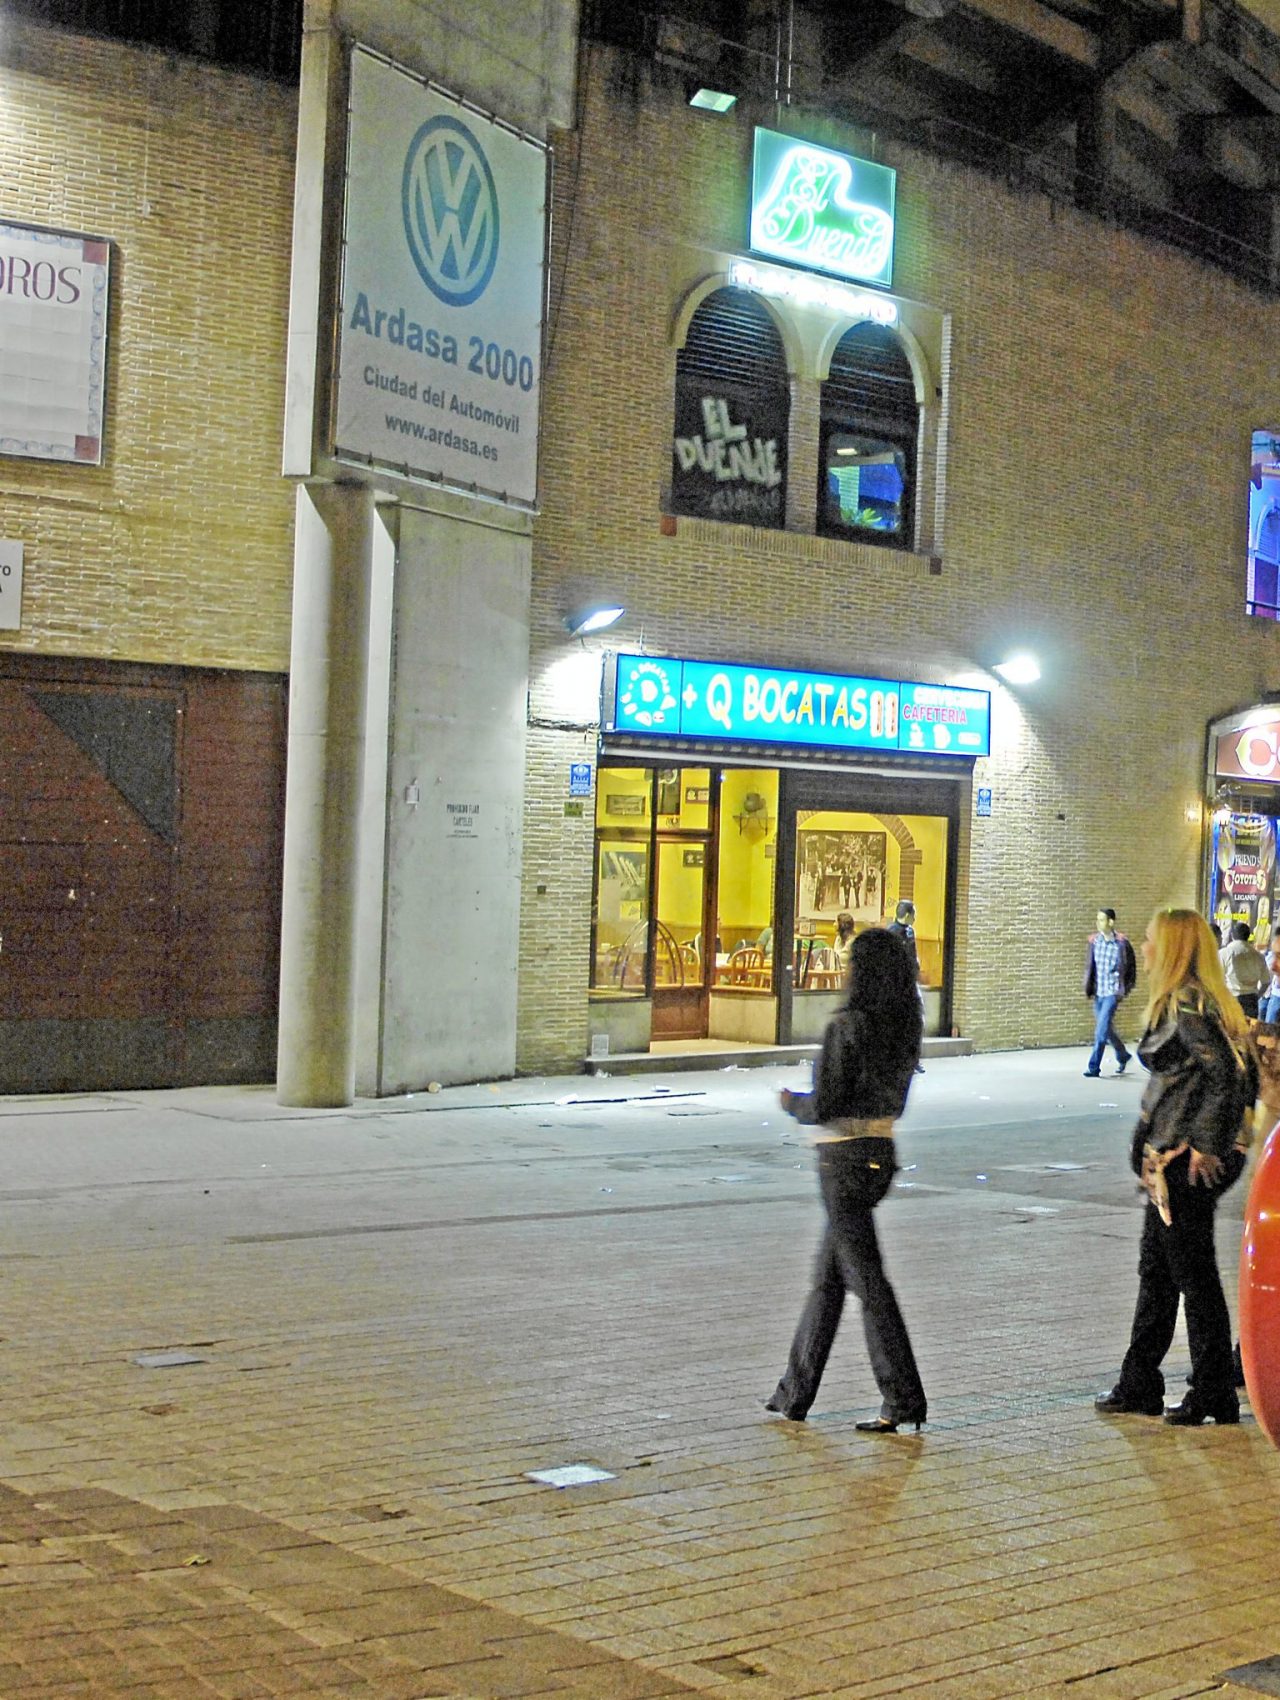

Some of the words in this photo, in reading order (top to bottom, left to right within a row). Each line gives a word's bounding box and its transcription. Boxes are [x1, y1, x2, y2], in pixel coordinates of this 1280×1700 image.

[0, 255, 82, 304] ROS
[350, 291, 458, 366] Ardasa
[467, 335, 533, 392] 2000
[363, 365, 418, 400] Ciudad
[422, 386, 445, 409] del
[449, 394, 520, 433] Automóvil
[702, 396, 748, 440] EL
[385, 413, 498, 462] www.ardasa.es
[706, 672, 732, 730] Q
[742, 674, 868, 731] BOCATAS
[903, 705, 967, 723] CAFETERIA
